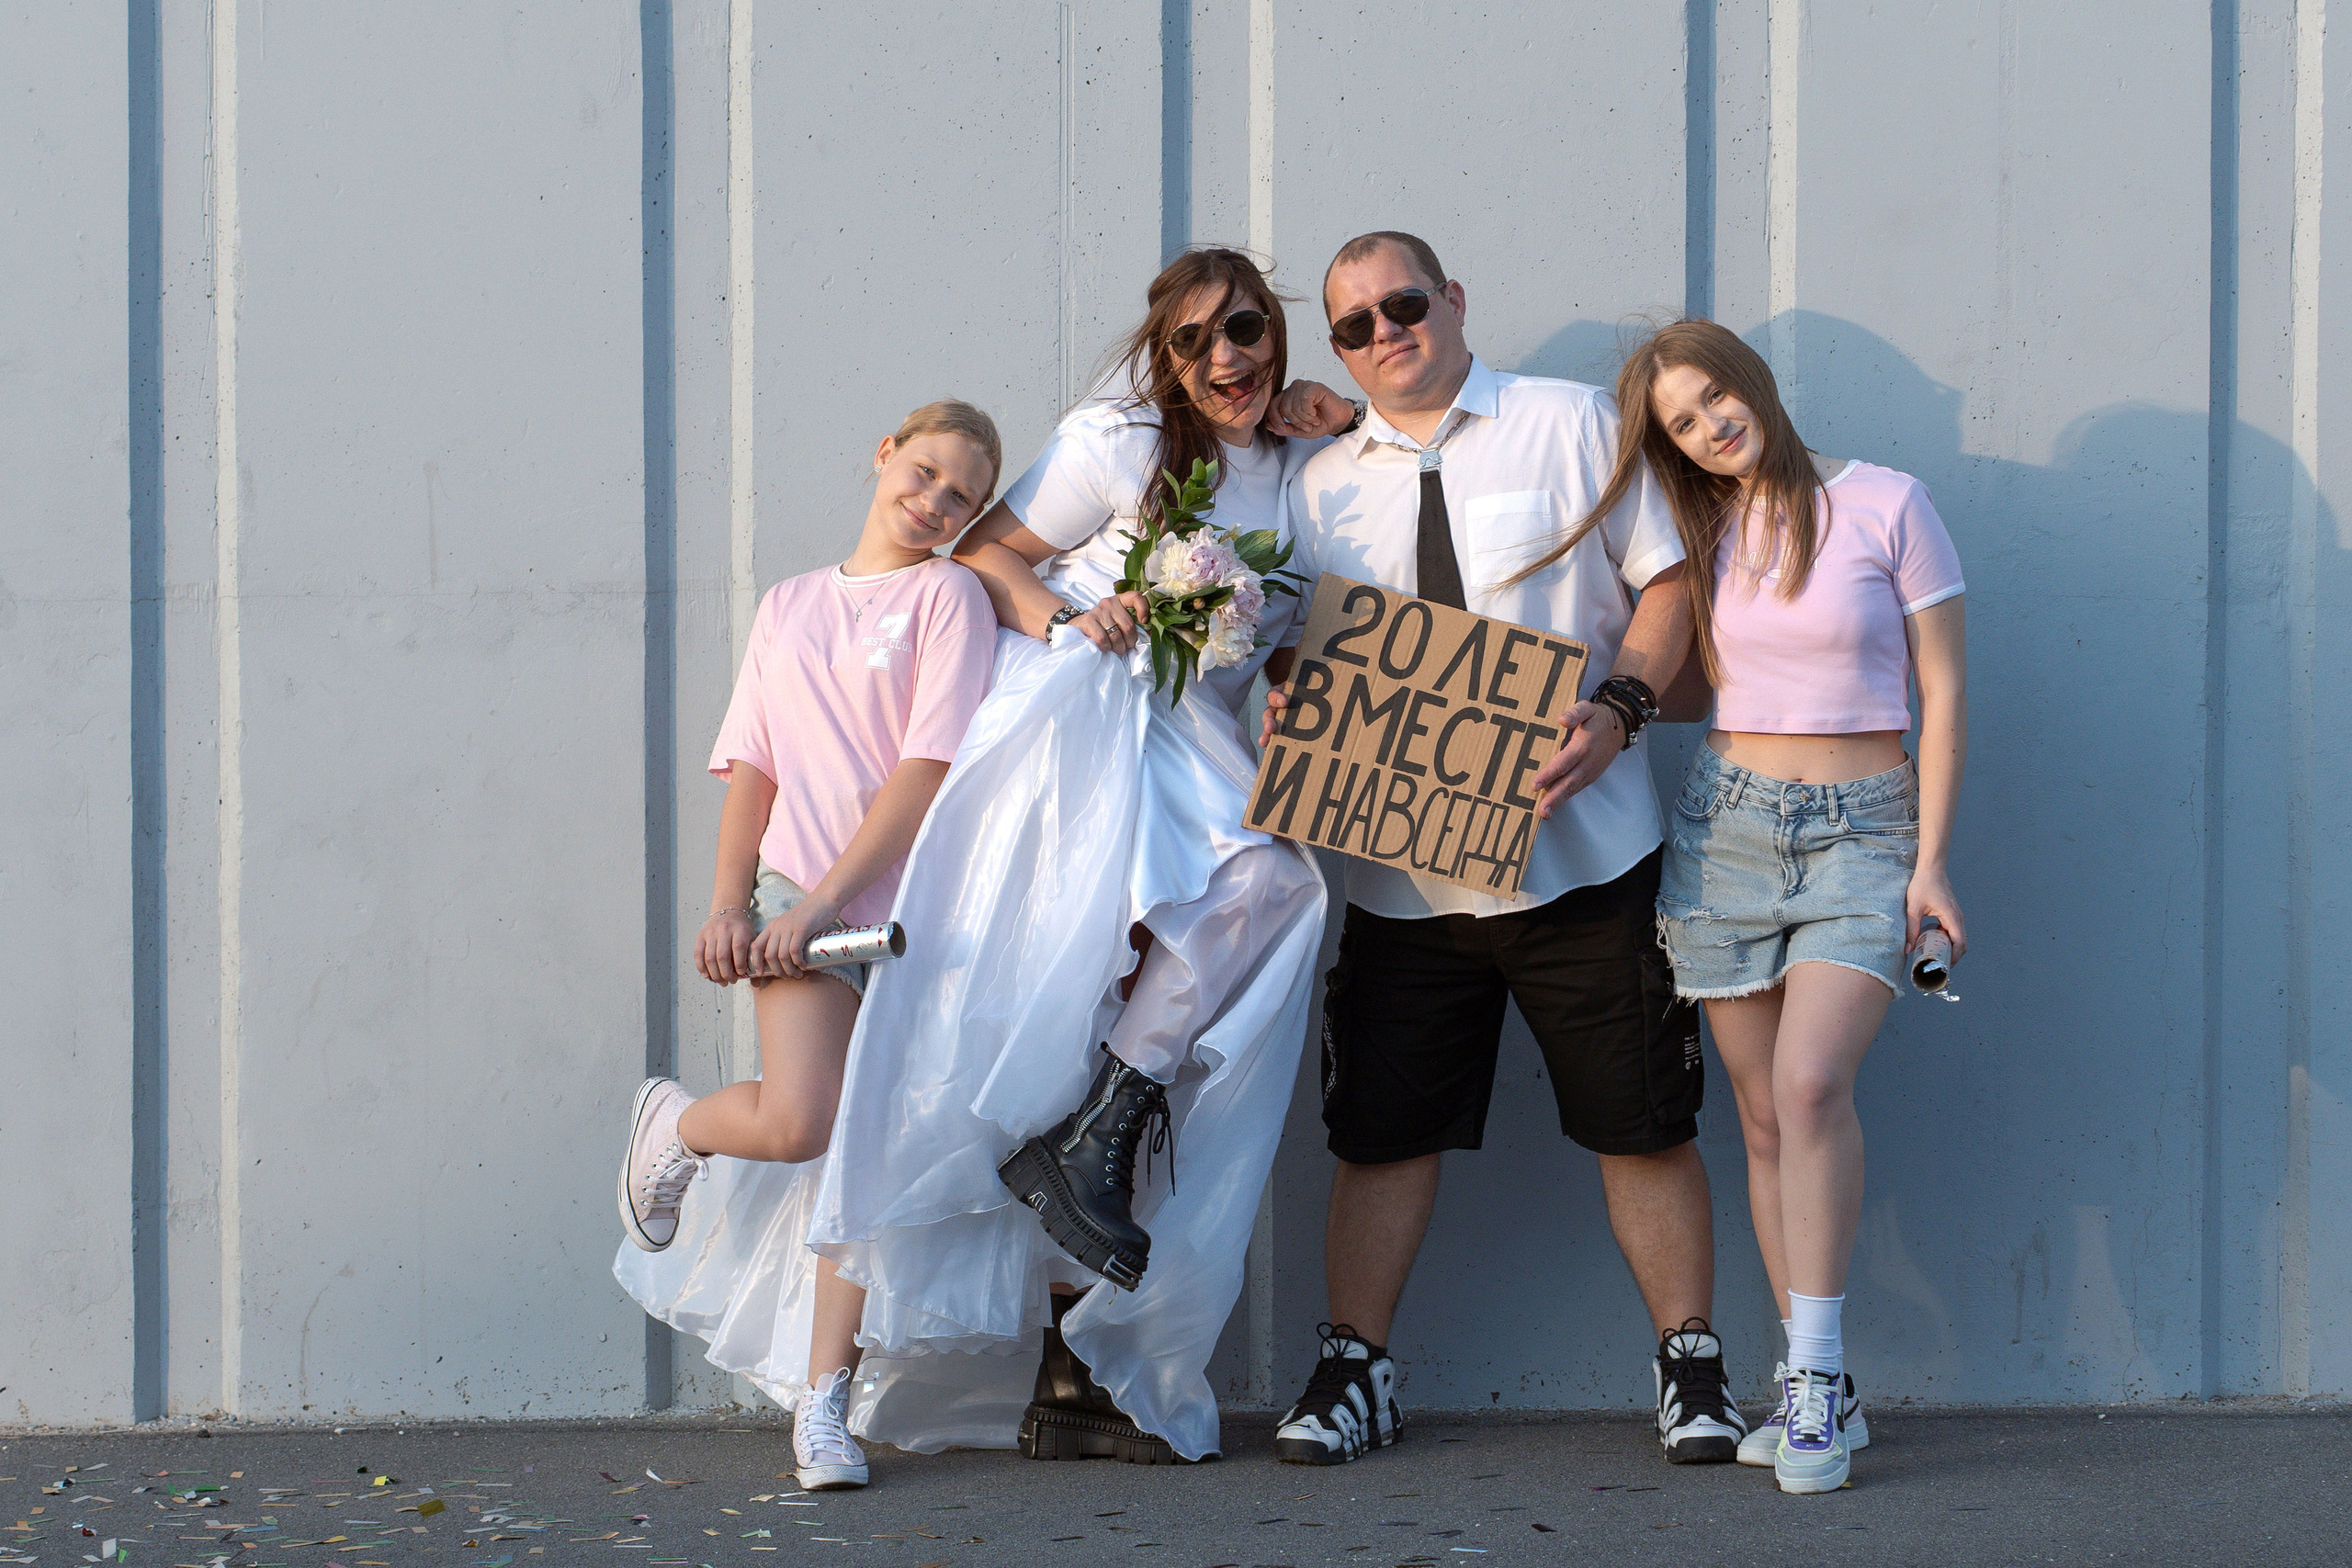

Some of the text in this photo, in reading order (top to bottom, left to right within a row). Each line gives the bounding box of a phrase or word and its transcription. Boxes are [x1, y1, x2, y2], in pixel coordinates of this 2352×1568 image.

[861, 637, 912, 652] BEST CLUB
[1322, 585, 1585, 718] 20 ЛЕТ
[1281, 659, 1558, 811] ВМЕСТЕ
[1250, 745, 1534, 893] И НАВСЕГДА
